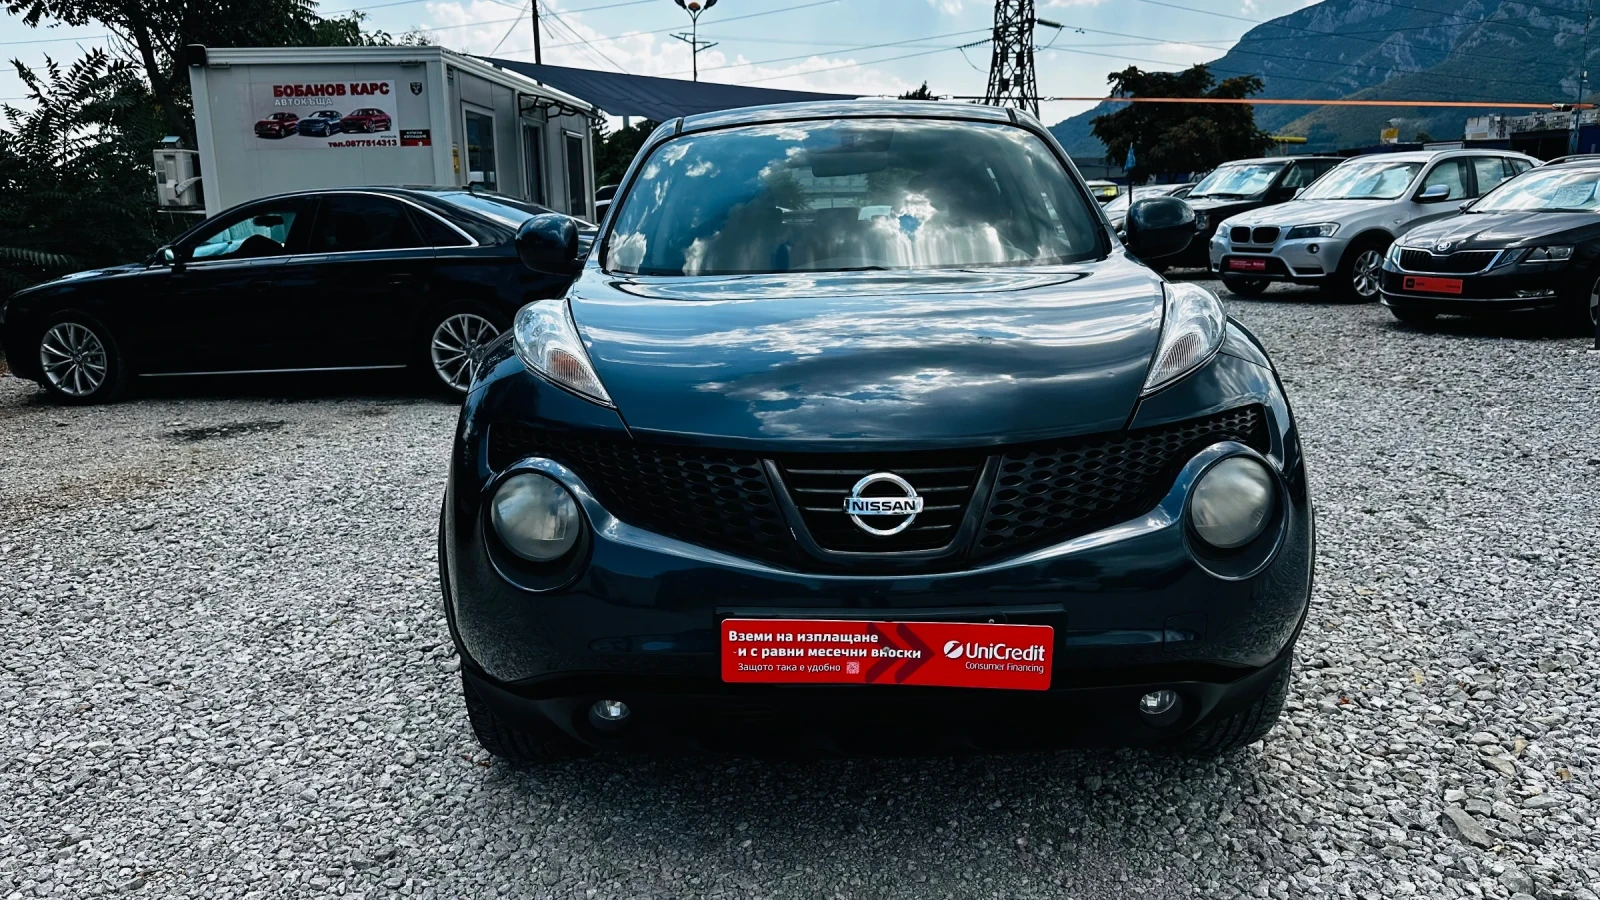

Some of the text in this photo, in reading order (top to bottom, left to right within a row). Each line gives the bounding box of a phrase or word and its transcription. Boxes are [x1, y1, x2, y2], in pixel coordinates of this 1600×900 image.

[273, 82, 390, 98] БОБАНОВ КАРС
[274, 97, 333, 107] АВТОКЪЩА
[852, 500, 916, 511] NISSAN
[728, 630, 879, 645] Вземи на изплащане
[738, 647, 921, 659] и с равни месечни вноски
[966, 642, 1045, 662] UniCredit
[738, 662, 841, 673] Защото така е удобно
[965, 661, 1044, 674] Consumer Financing
